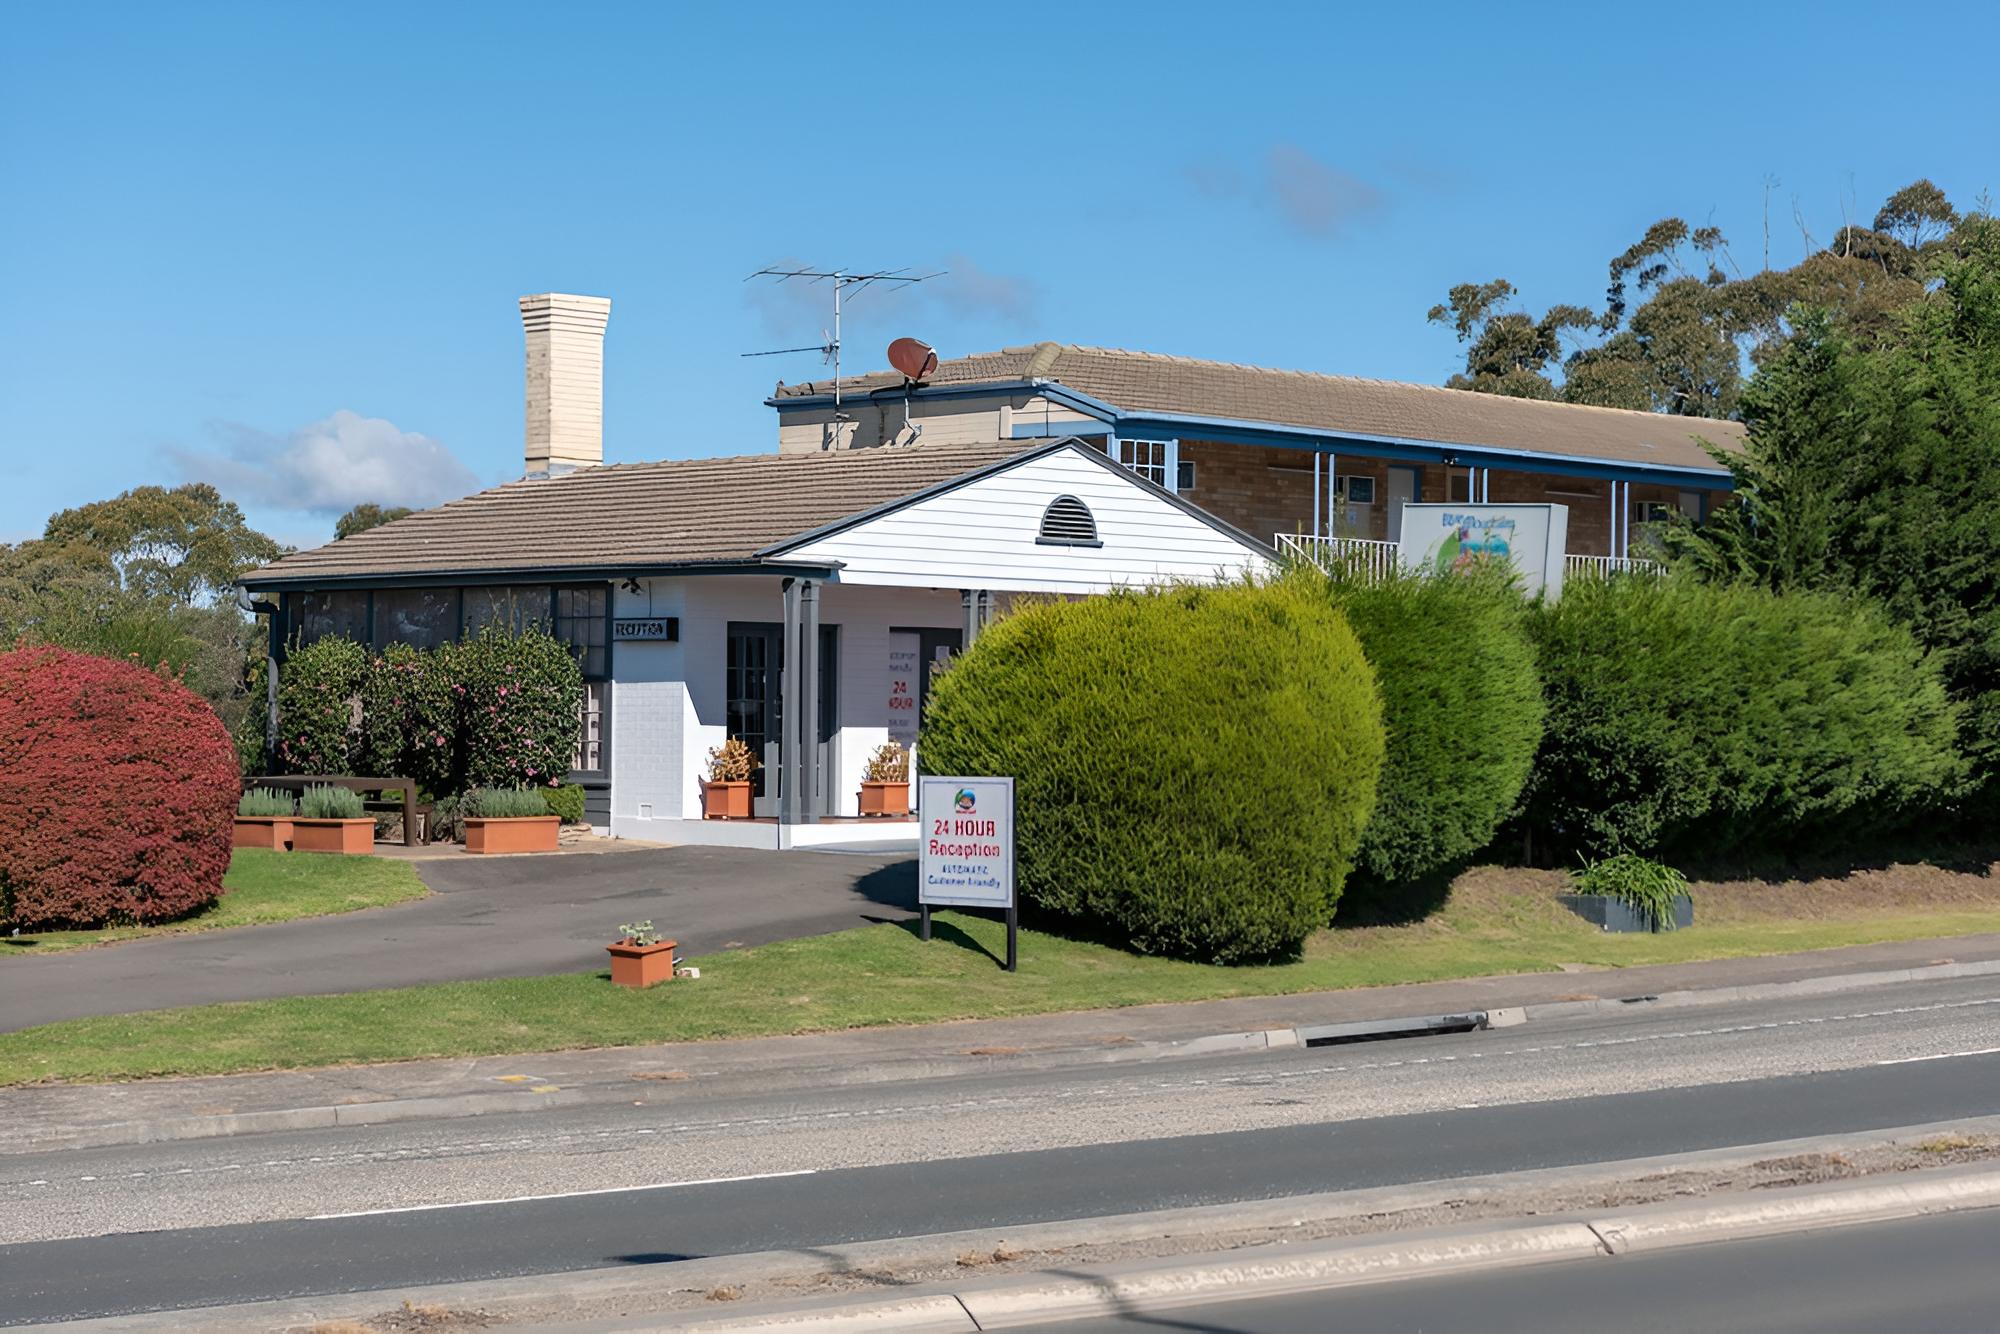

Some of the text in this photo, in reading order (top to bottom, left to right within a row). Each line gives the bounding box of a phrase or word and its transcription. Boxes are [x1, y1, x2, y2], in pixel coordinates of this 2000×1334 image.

[934, 819, 995, 837] 24 HOUR
[929, 839, 1000, 860] Reception
